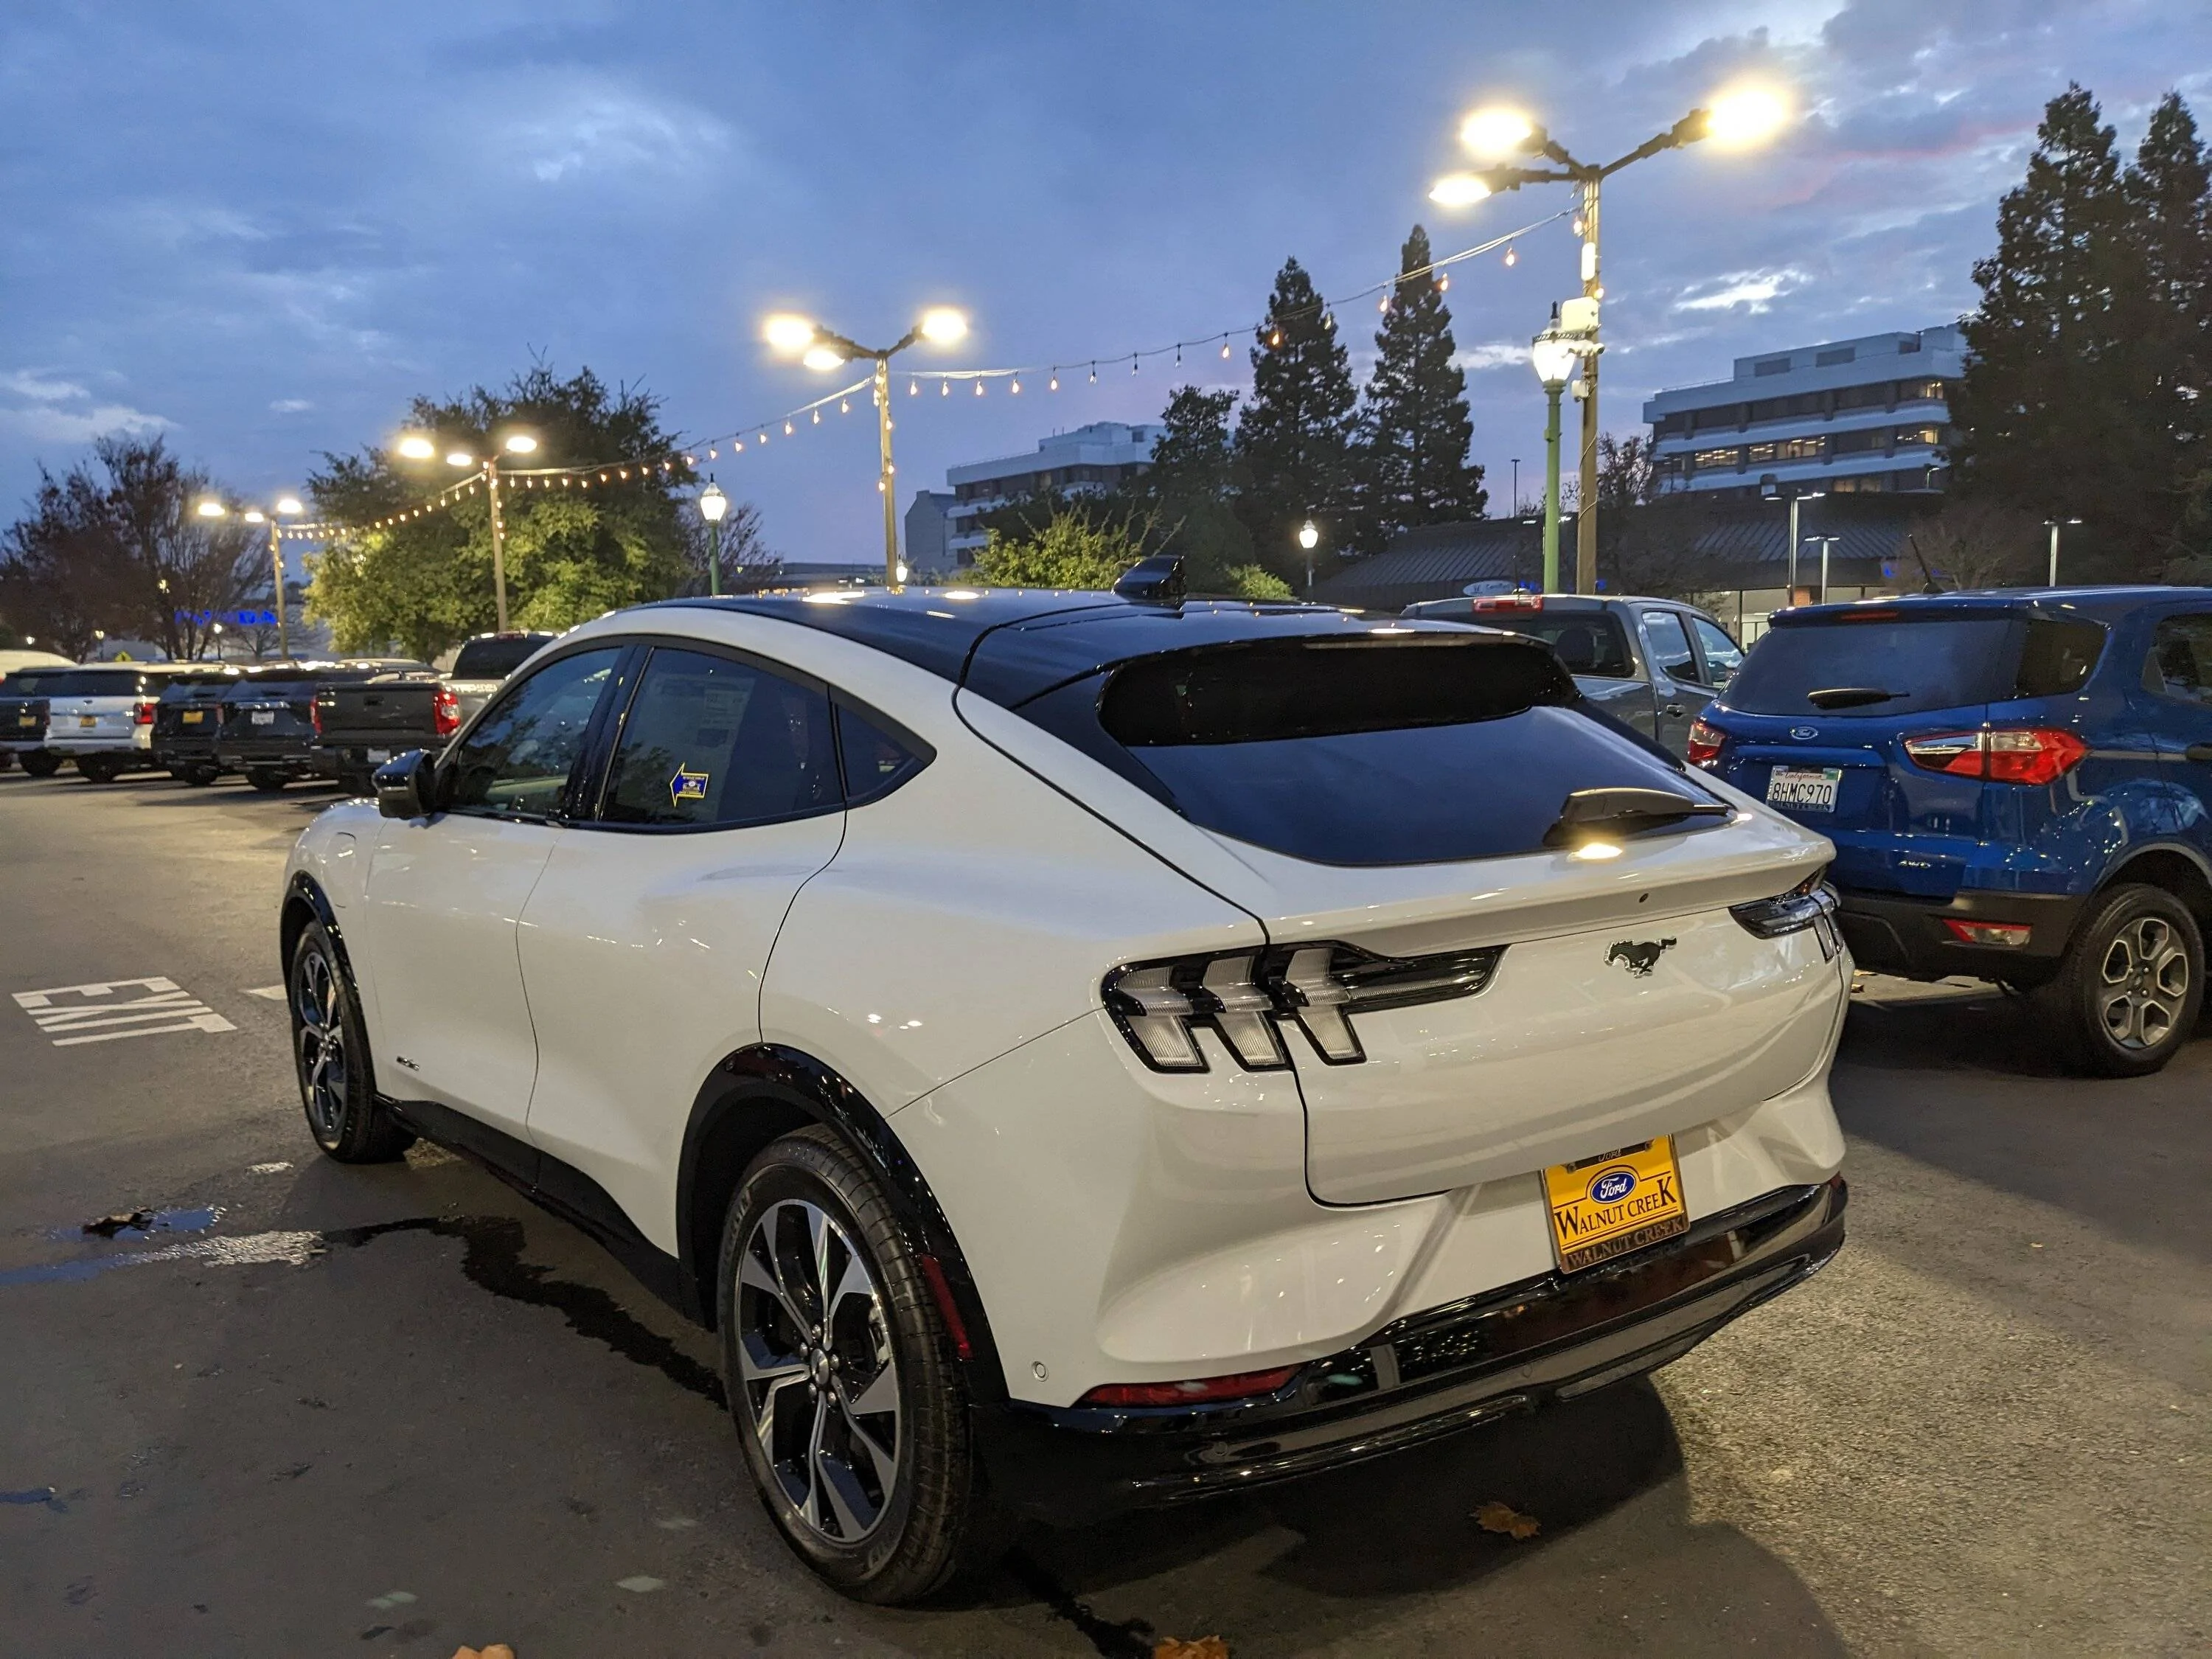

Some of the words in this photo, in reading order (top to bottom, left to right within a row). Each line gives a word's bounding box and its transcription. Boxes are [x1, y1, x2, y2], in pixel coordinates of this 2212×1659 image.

[1772, 782, 1832, 804] 8HMC970
[1599, 1178, 1627, 1199] Ford
[1554, 1204, 1625, 1240] WALNUT
[1627, 1176, 1677, 1217] CREEK
[1568, 1235, 1632, 1269] WALNUT
[1633, 1216, 1684, 1245] CREEK
